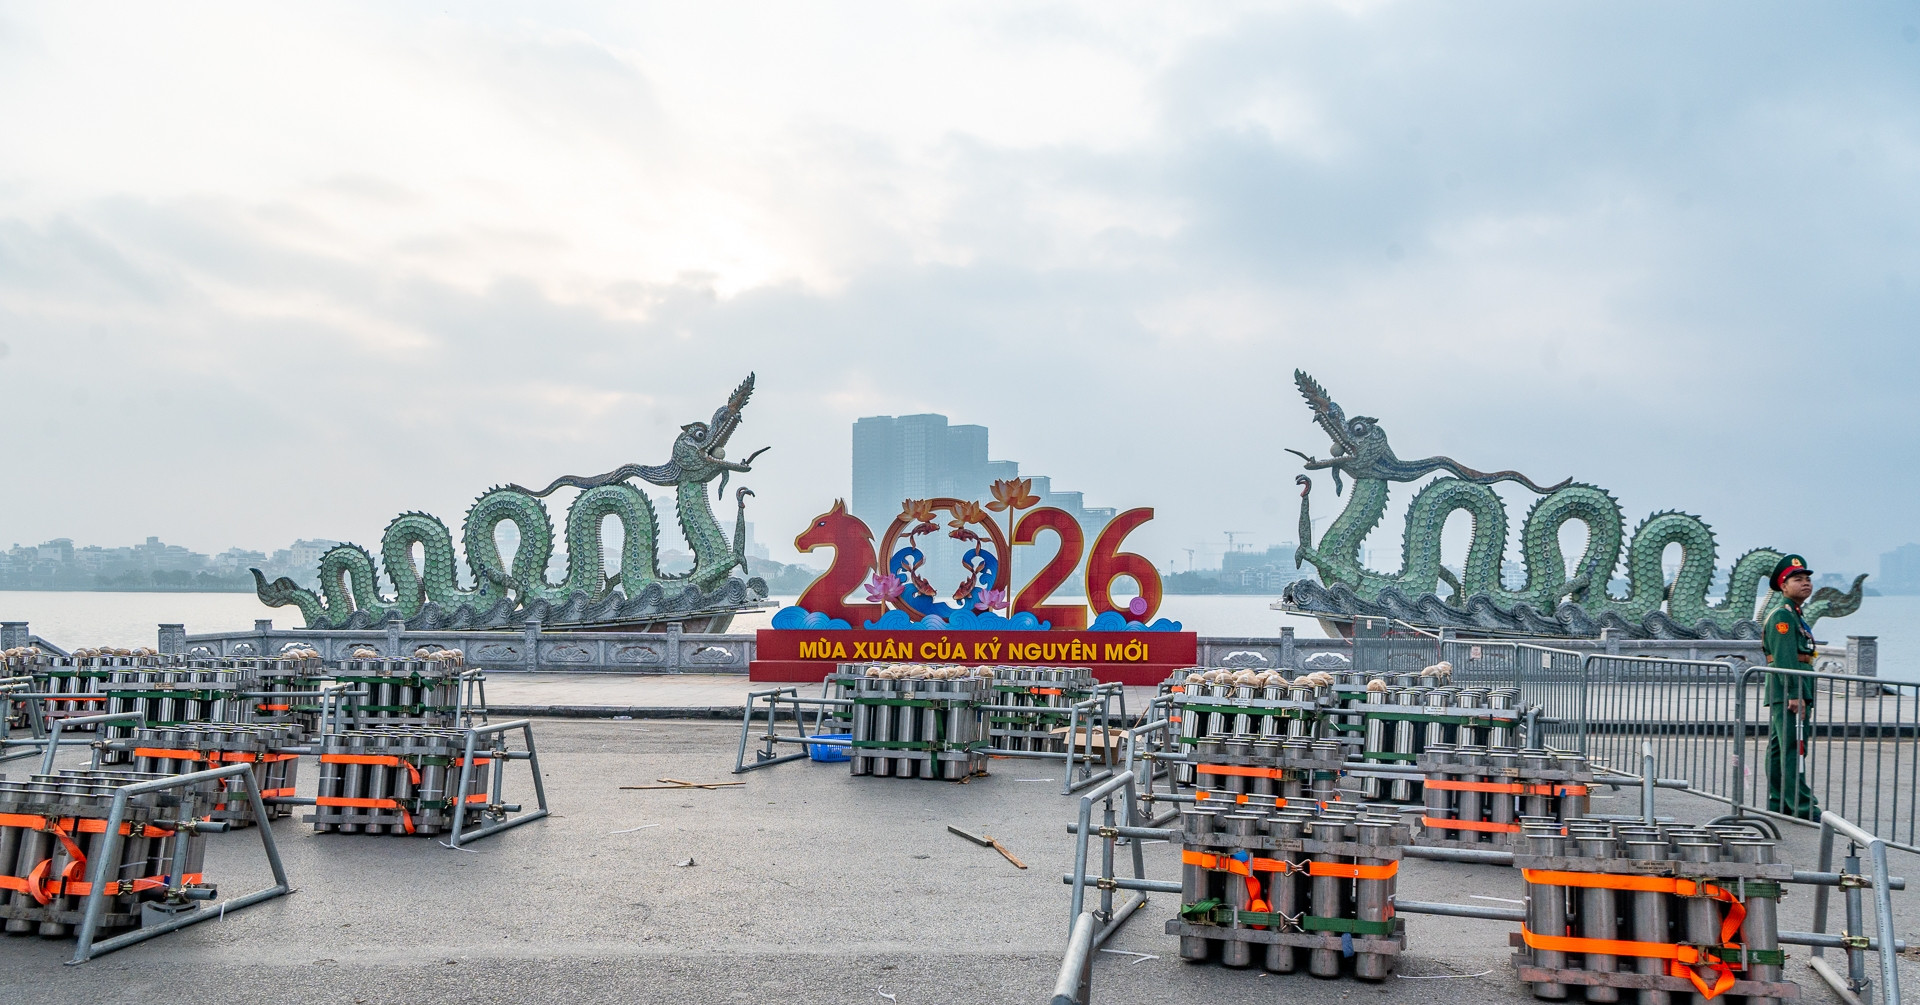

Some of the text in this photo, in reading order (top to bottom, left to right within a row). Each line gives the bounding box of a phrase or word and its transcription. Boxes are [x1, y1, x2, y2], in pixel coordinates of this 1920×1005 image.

[794, 498, 1163, 630] 2026
[800, 636, 1149, 661] MÙA XUÂN CỦA KỶ NGUYÊN MỚI
